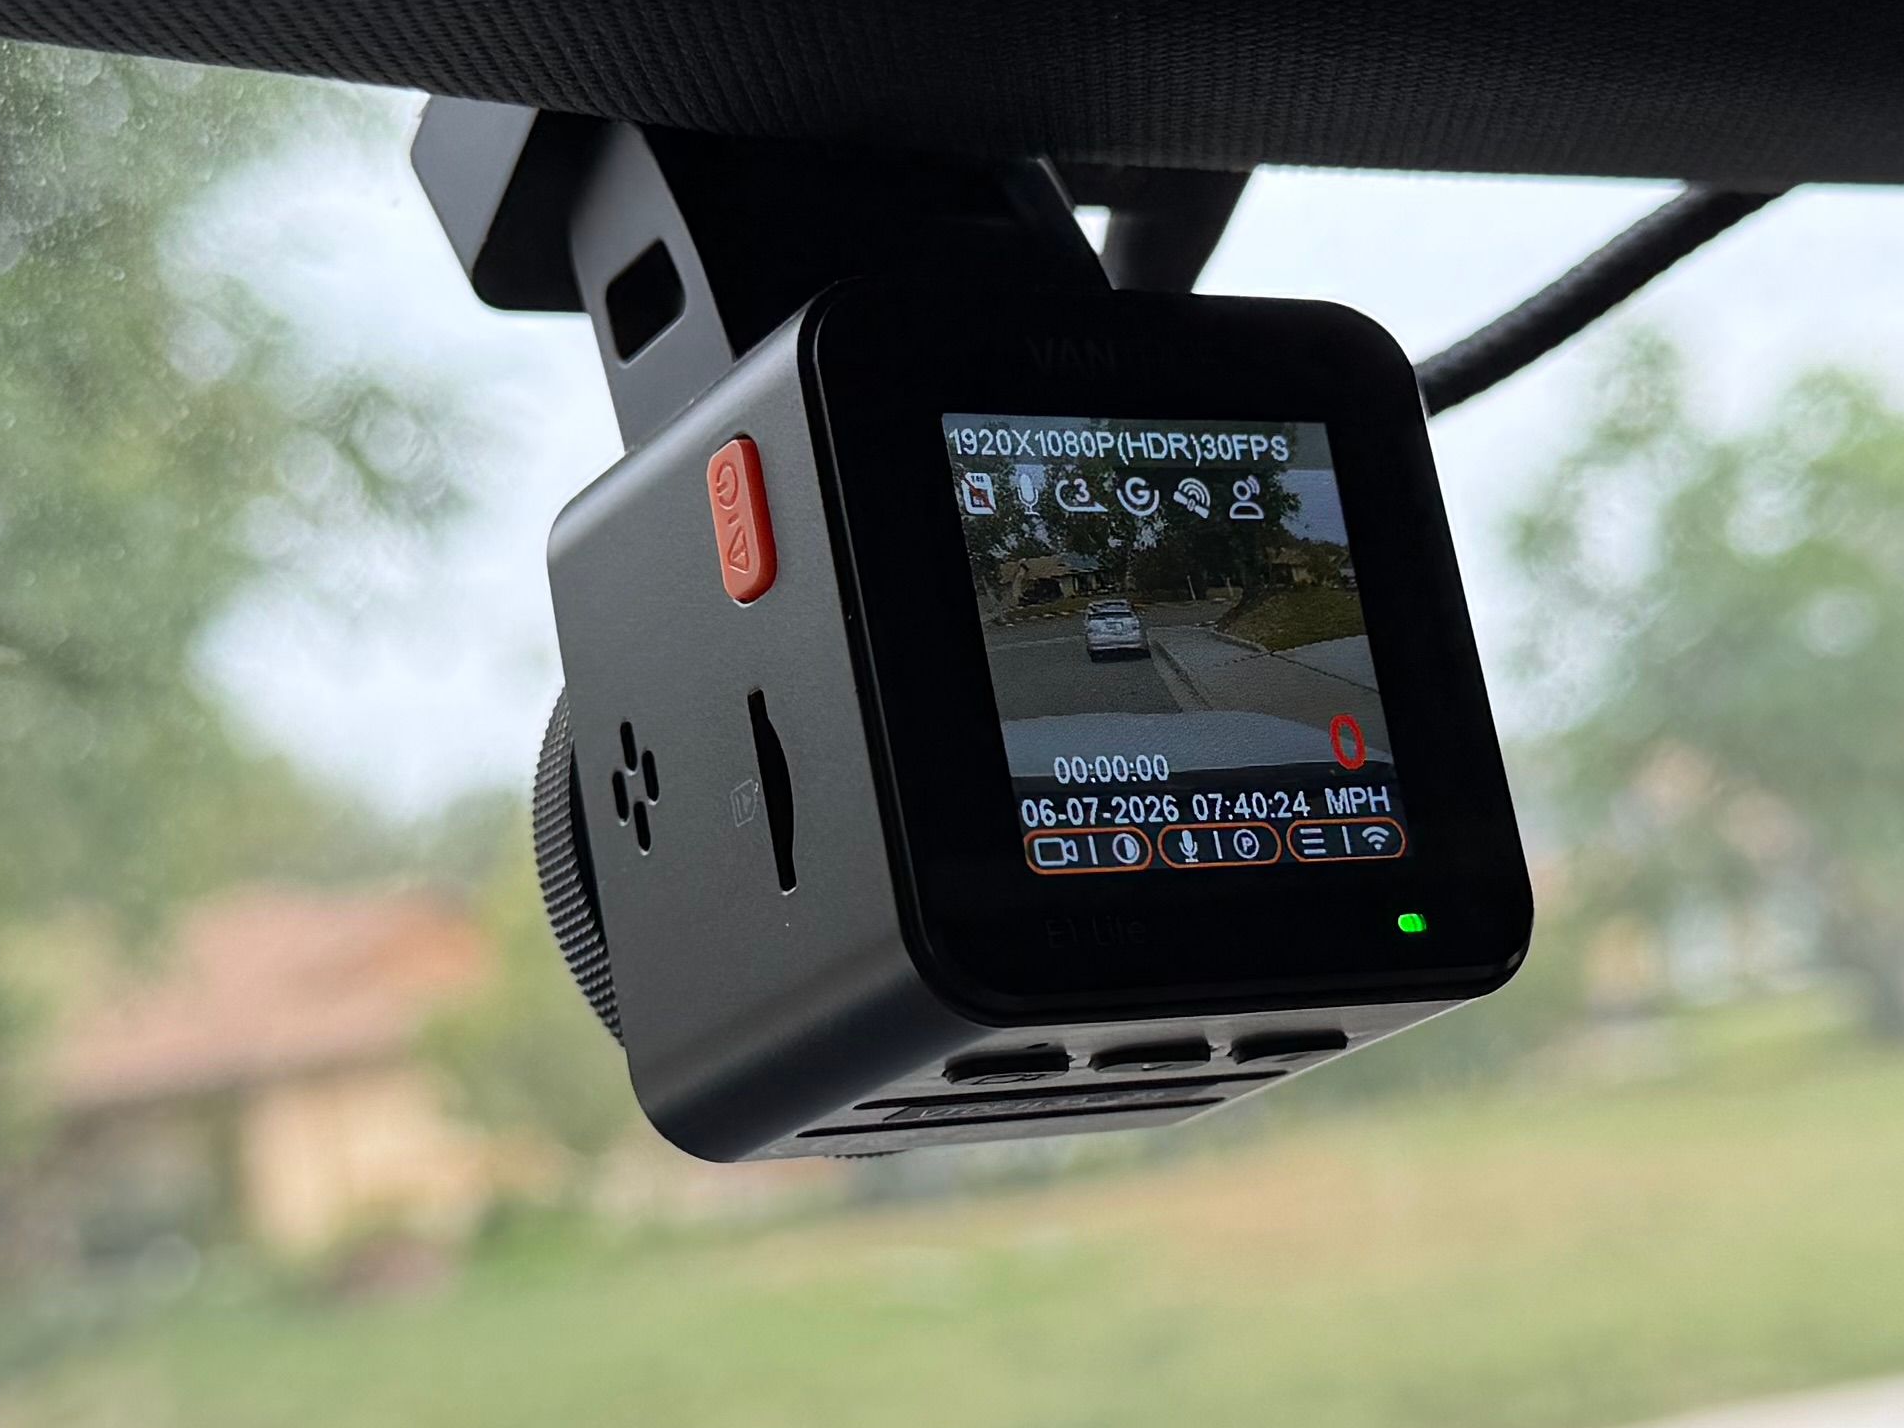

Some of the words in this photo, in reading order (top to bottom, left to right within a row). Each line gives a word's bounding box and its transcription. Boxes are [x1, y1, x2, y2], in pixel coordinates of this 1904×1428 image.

[948, 427, 1290, 467] 1920X1080P(HDR)30FPS
[1328, 713, 1367, 770] 0
[1053, 754, 1170, 784] 00:00:00
[1021, 795, 1180, 828] 06-07-2026
[1192, 790, 1312, 821] 07:40:24
[1324, 786, 1392, 815] MPH
